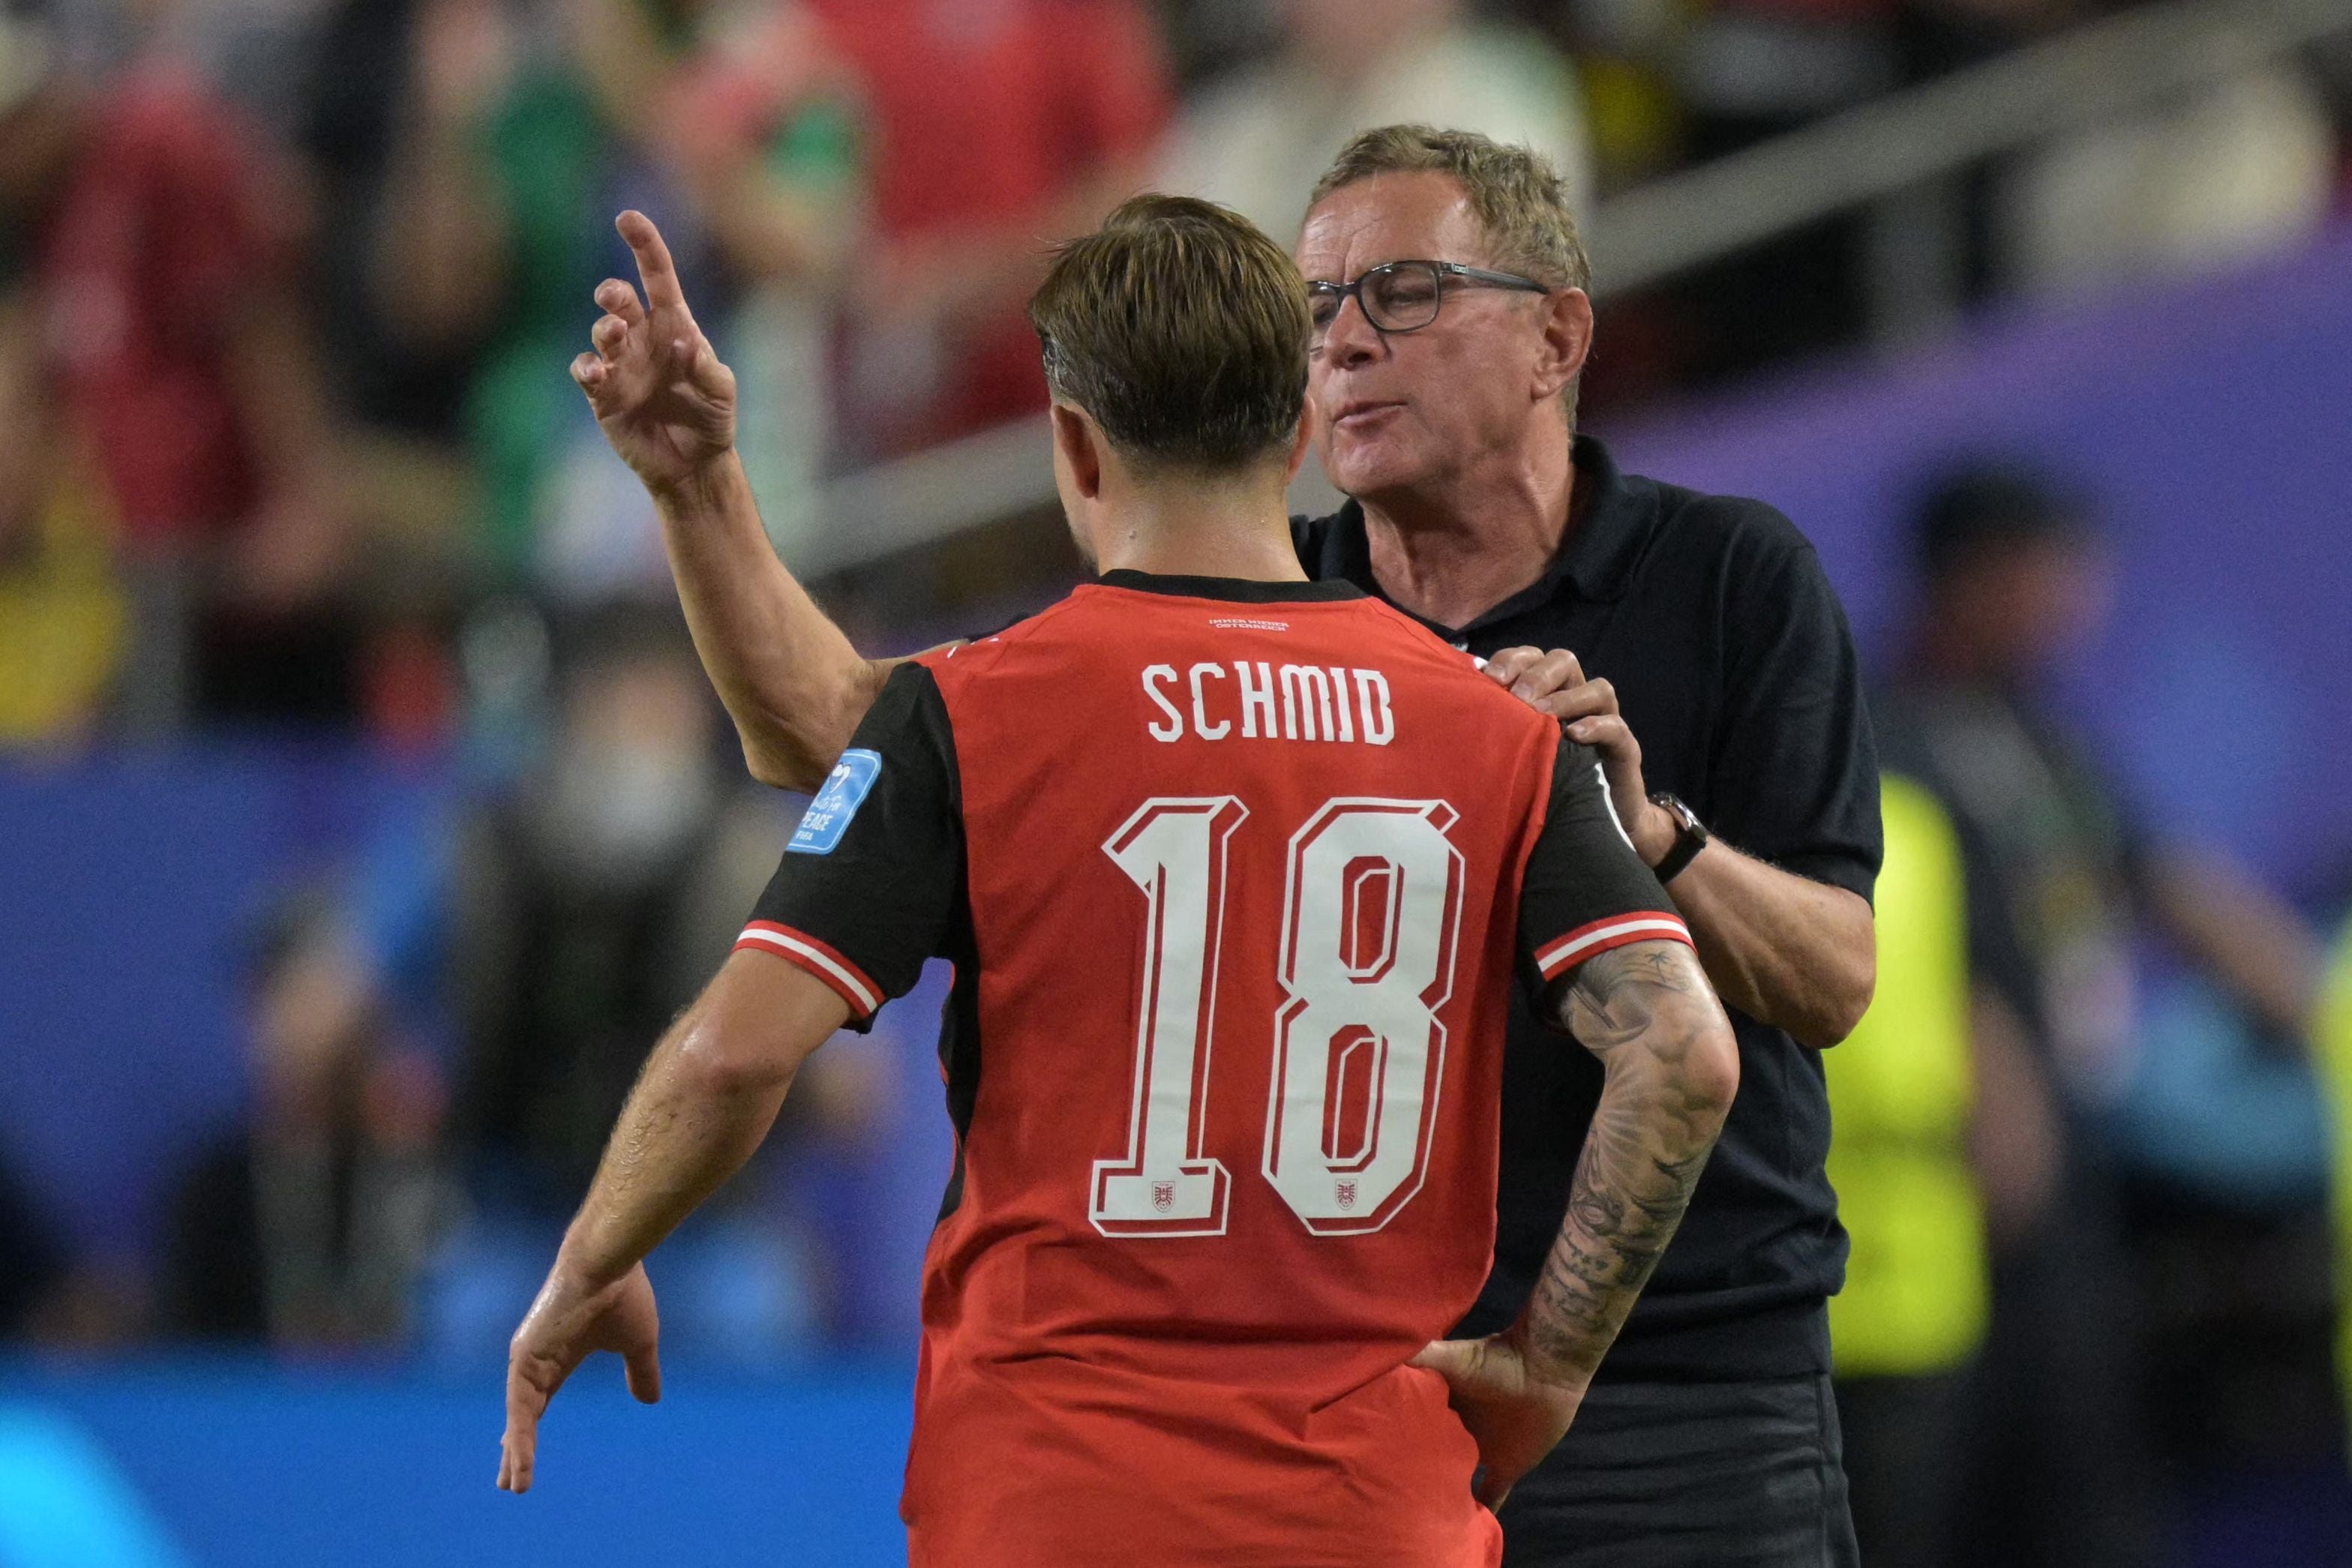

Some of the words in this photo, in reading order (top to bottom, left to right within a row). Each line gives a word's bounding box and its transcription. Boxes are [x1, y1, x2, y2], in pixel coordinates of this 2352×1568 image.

[1142, 661, 1395, 746] SCHMID
[796, 830, 814, 841] FIFA
[802, 811, 833, 832] PEACE
[1088, 795, 1466, 1237] 18
